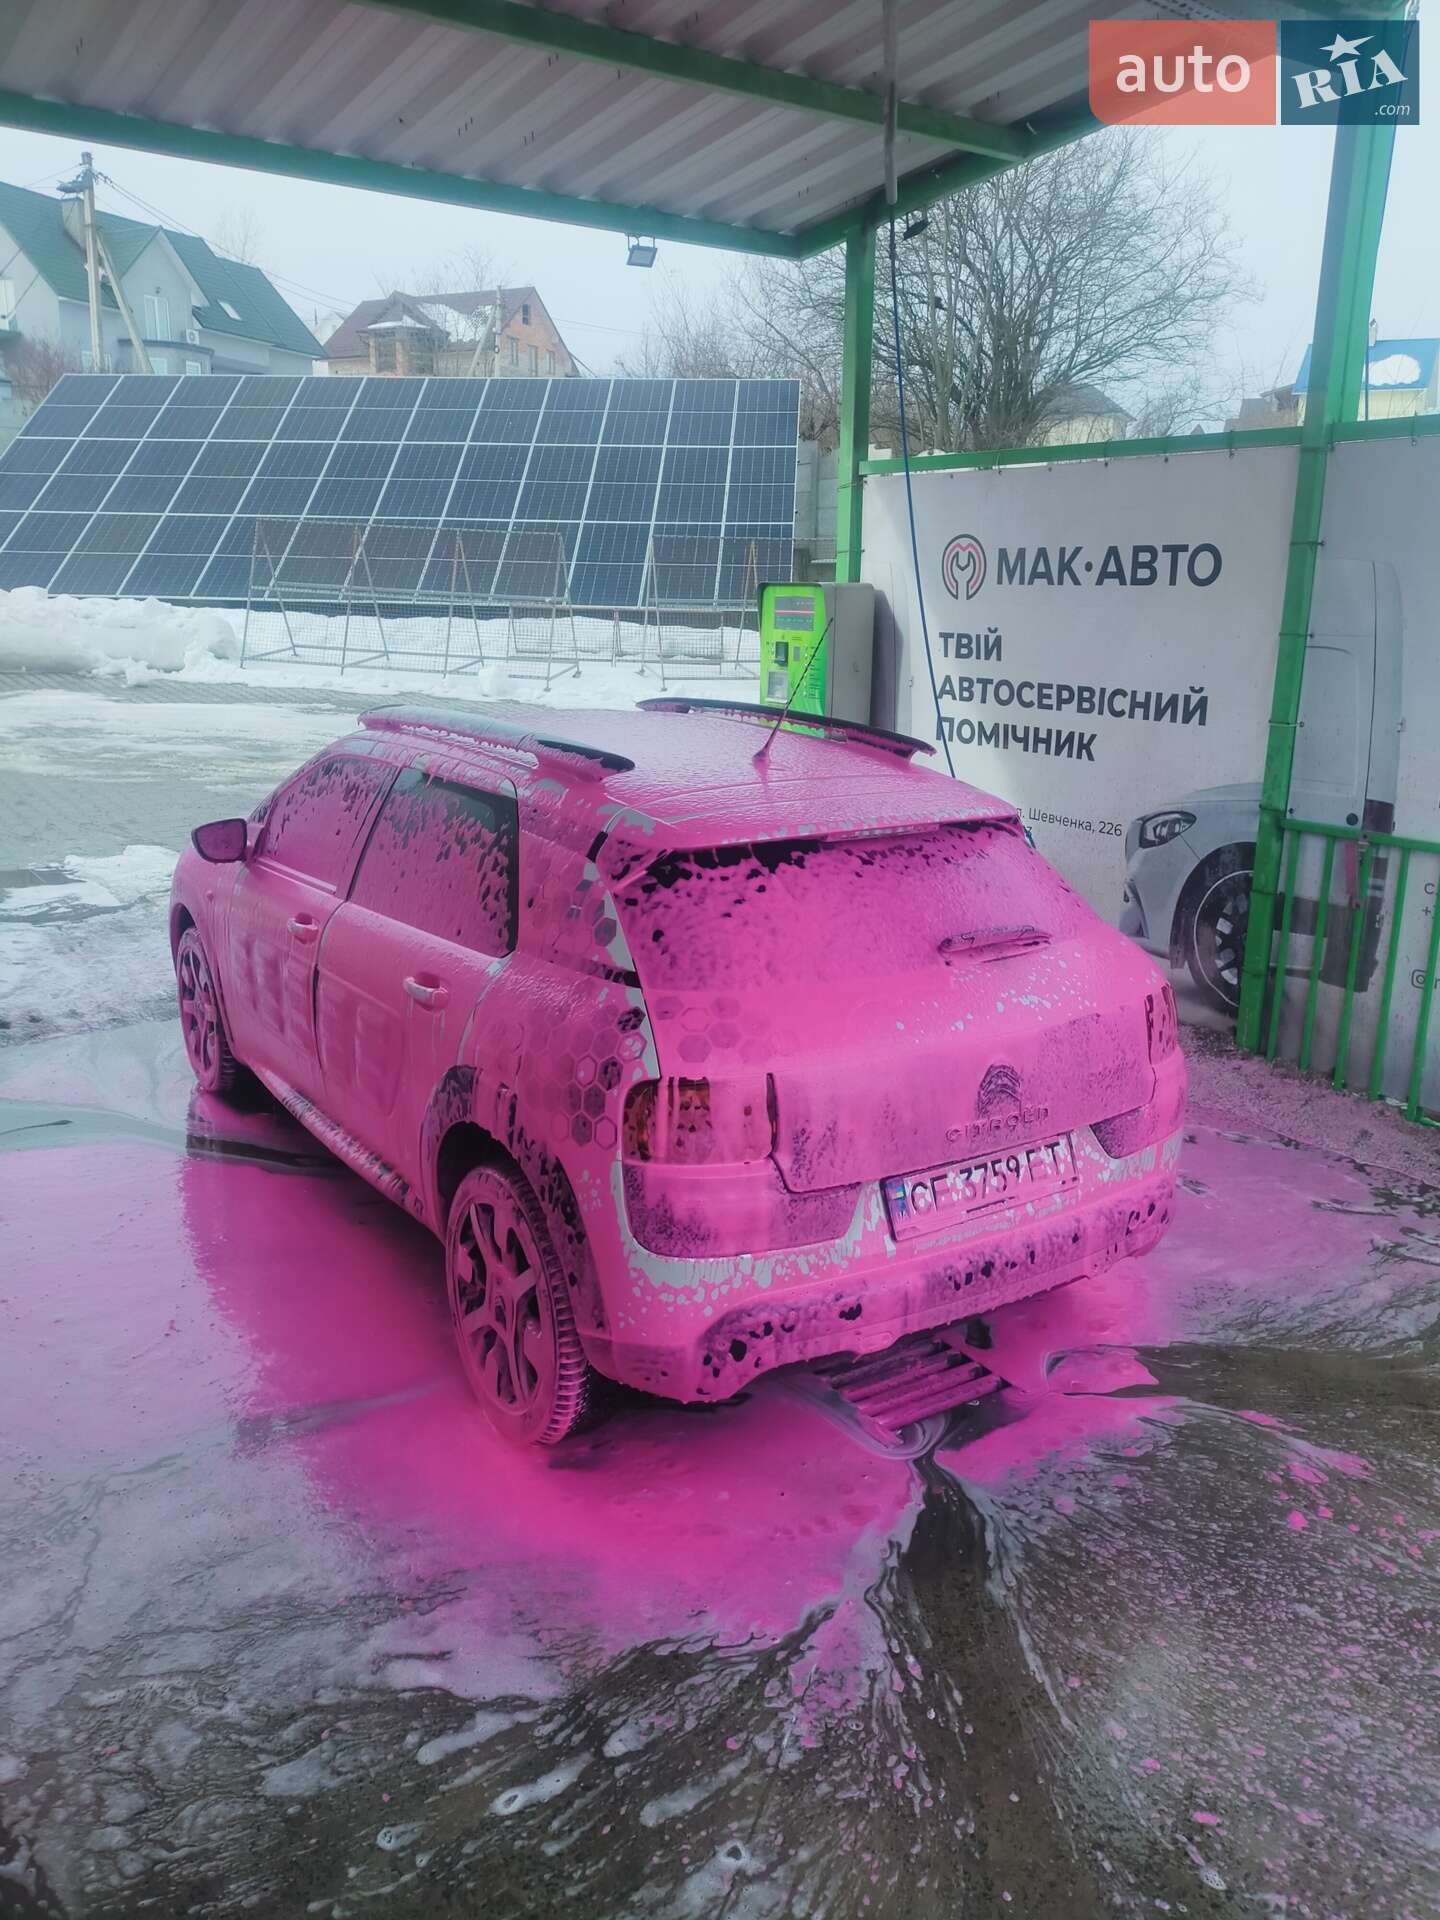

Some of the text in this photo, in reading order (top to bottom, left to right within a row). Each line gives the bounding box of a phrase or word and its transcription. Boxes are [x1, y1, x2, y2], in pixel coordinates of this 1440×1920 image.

[938, 627, 1003, 662] ТВІЙ
[937, 674, 1209, 726] АВТОСЕРВІСНИЙ
[935, 716, 1098, 762] ПОМІЧНИК
[1028, 807, 1095, 834] Шевченка,
[1098, 820, 1123, 837] 226
[959, 1154, 1020, 1201] 3759
